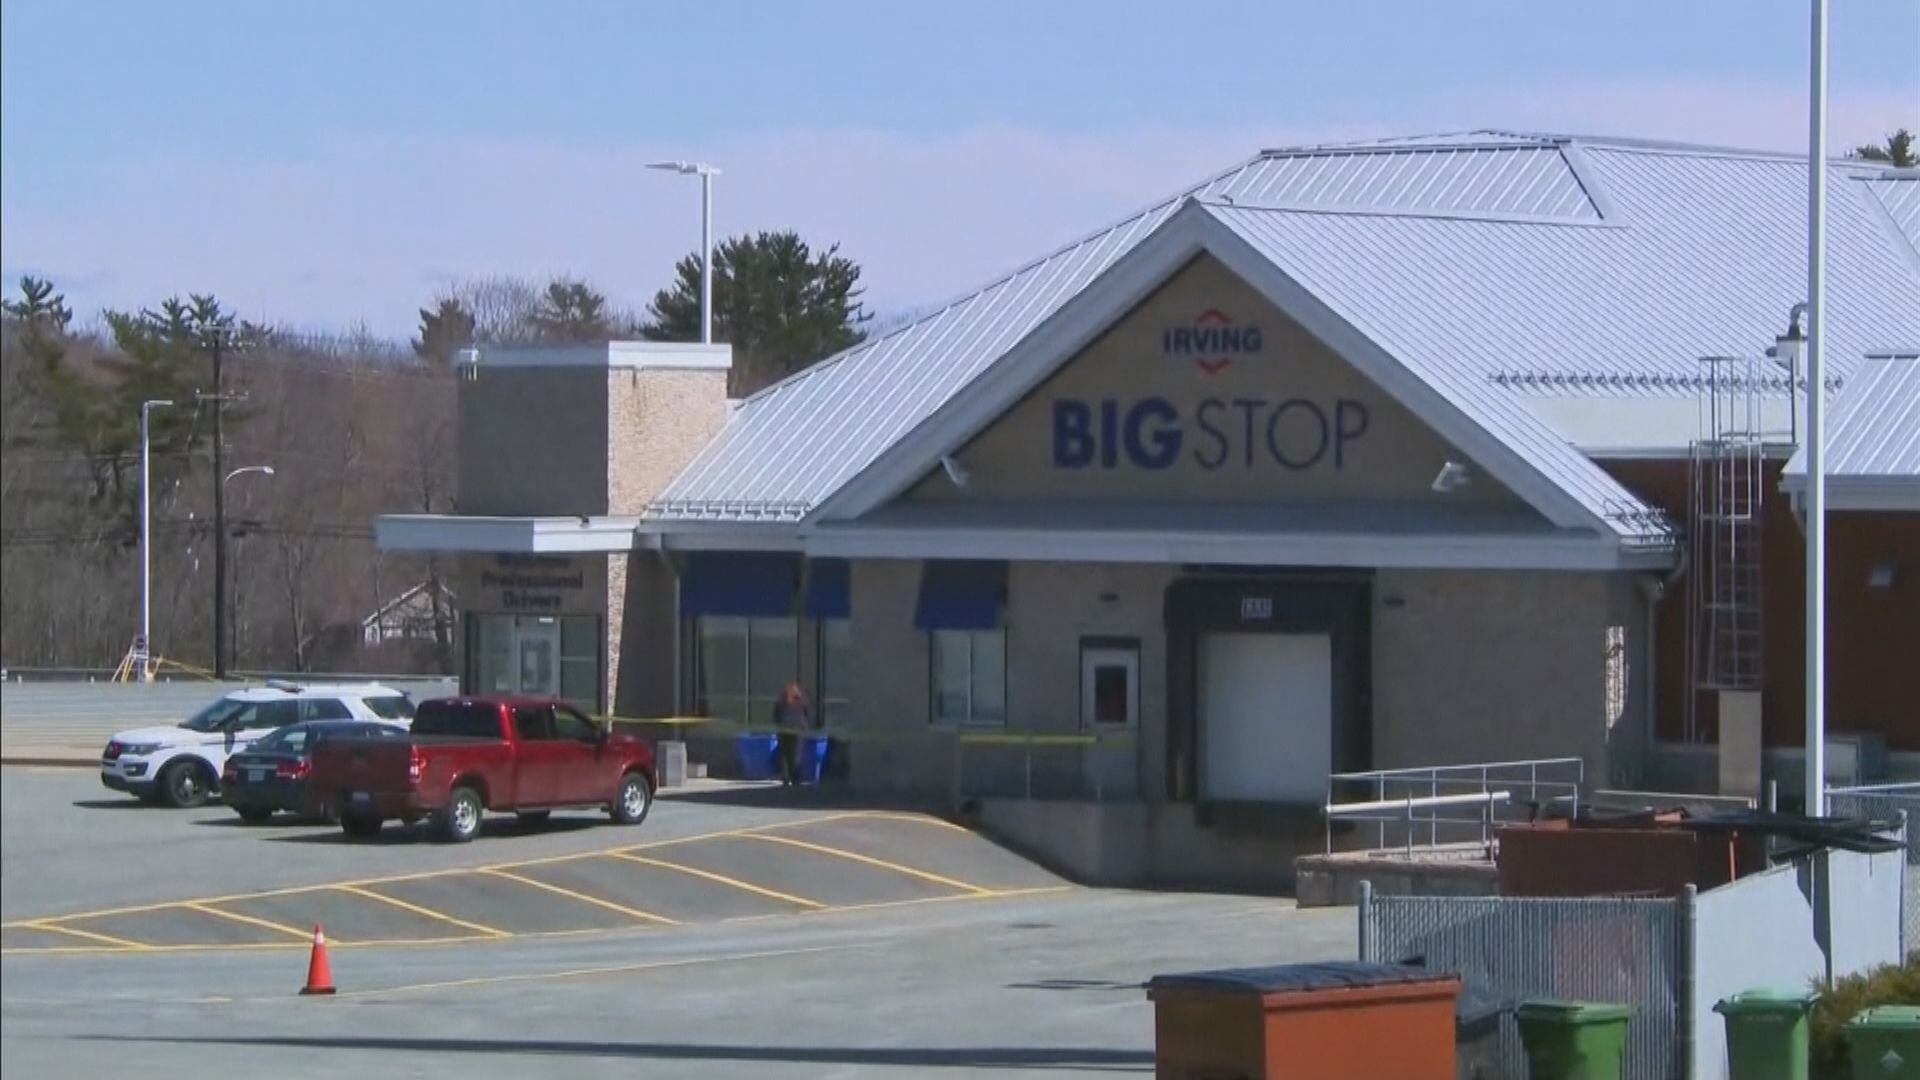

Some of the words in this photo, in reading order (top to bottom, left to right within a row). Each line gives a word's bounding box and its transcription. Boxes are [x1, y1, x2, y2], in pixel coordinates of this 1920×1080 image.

[1163, 328, 1262, 353] IRVING
[1053, 397, 1183, 470] BIG
[1194, 398, 1368, 470] STOP
